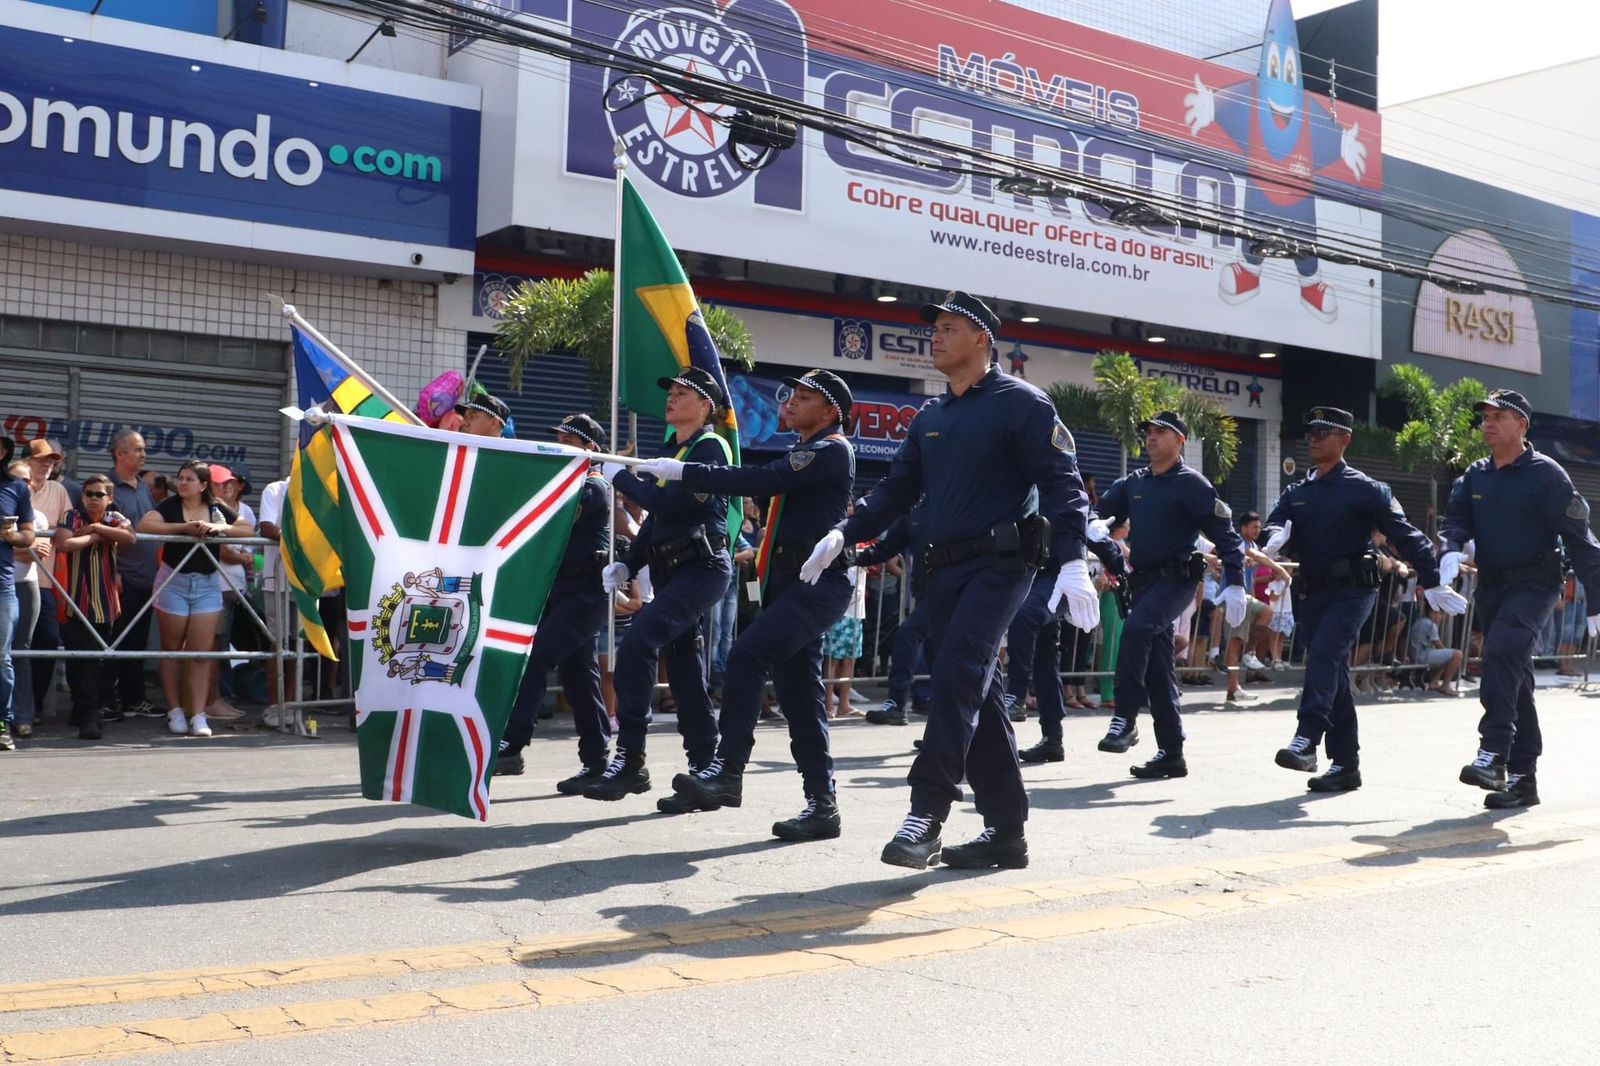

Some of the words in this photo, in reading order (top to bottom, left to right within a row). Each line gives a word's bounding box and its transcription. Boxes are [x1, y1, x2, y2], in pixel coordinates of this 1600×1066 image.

[846, 181, 923, 215] Cobre
[929, 201, 1040, 237] qualquer
[1121, 238, 1146, 258] do
[929, 229, 1150, 282] www.redeestrela.com.br
[1446, 297, 1514, 345] RASSI
